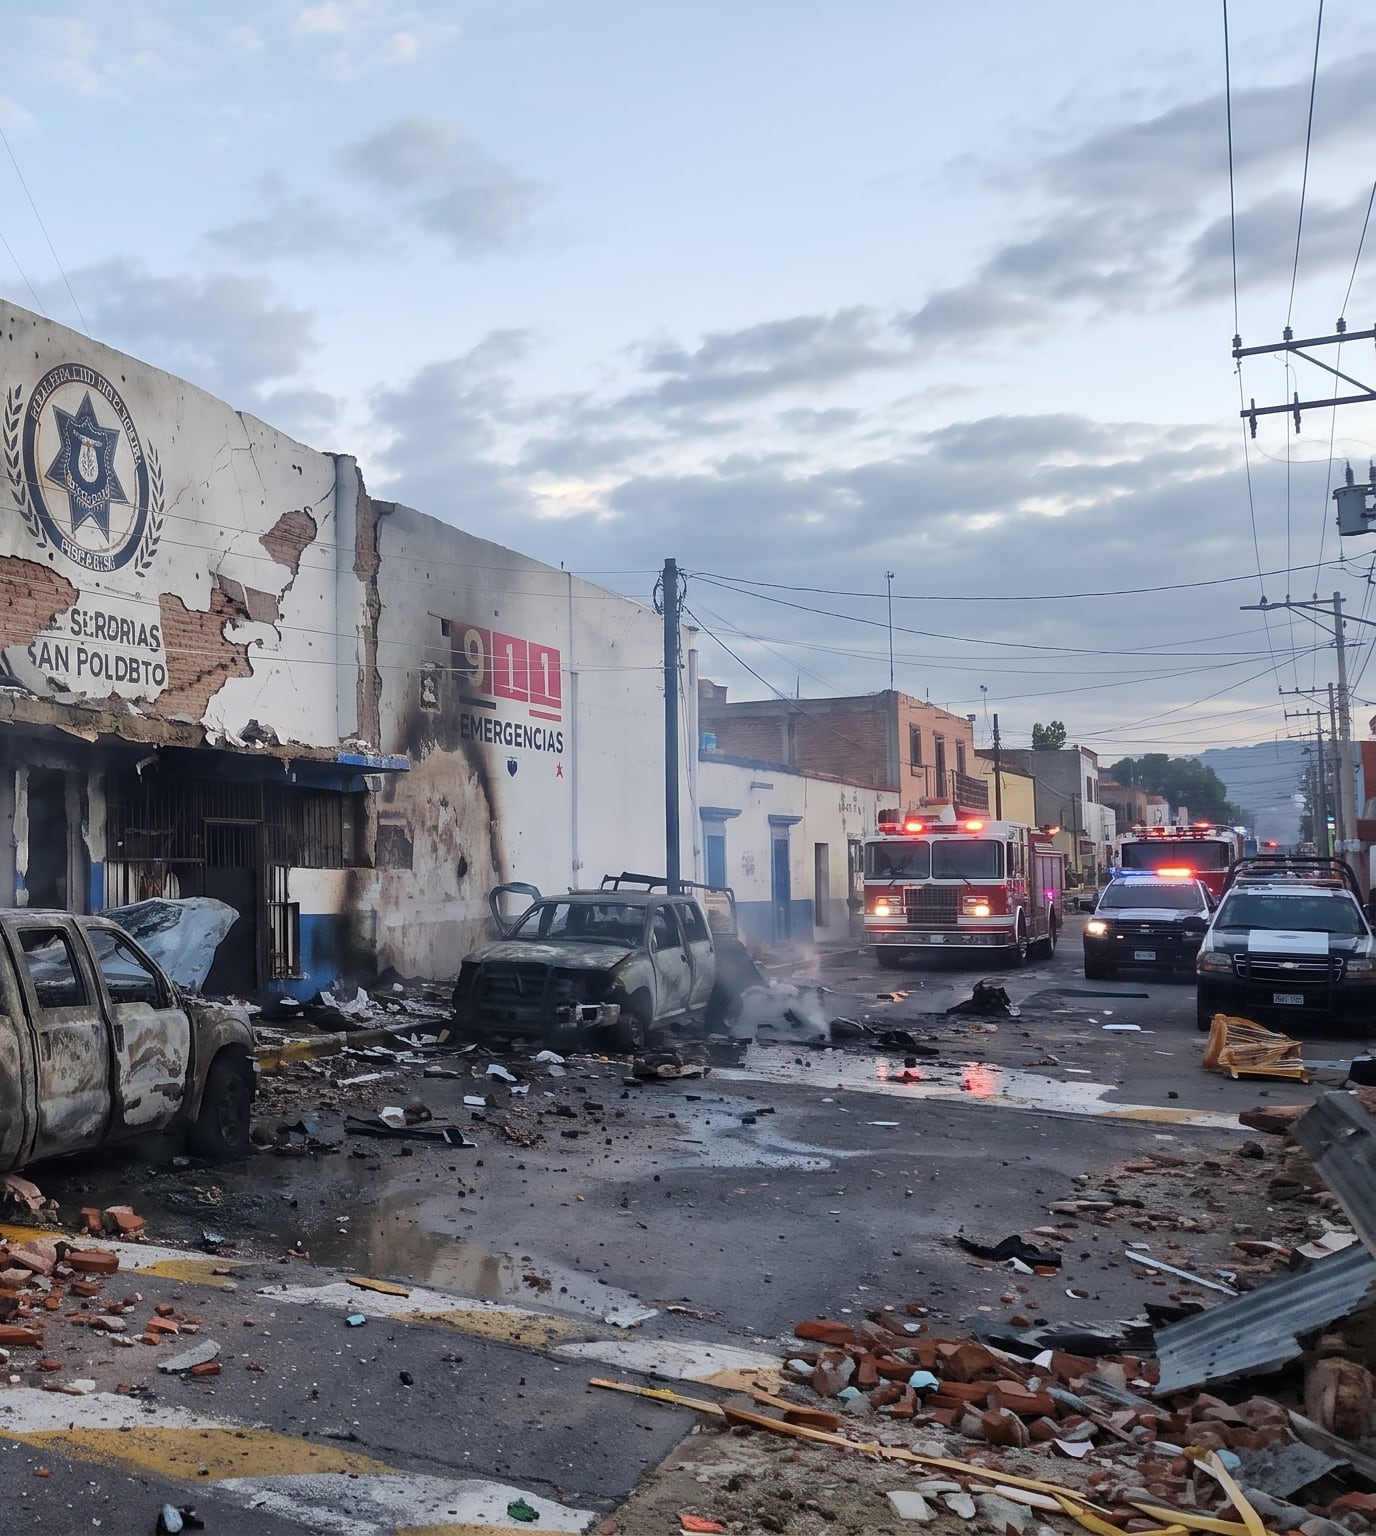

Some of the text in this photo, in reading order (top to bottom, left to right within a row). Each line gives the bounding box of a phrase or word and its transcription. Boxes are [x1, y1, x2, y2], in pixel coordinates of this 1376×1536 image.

[27, 641, 70, 673] SAN
[463, 628, 550, 698] 911
[460, 713, 564, 754] EMERGENCIAS
